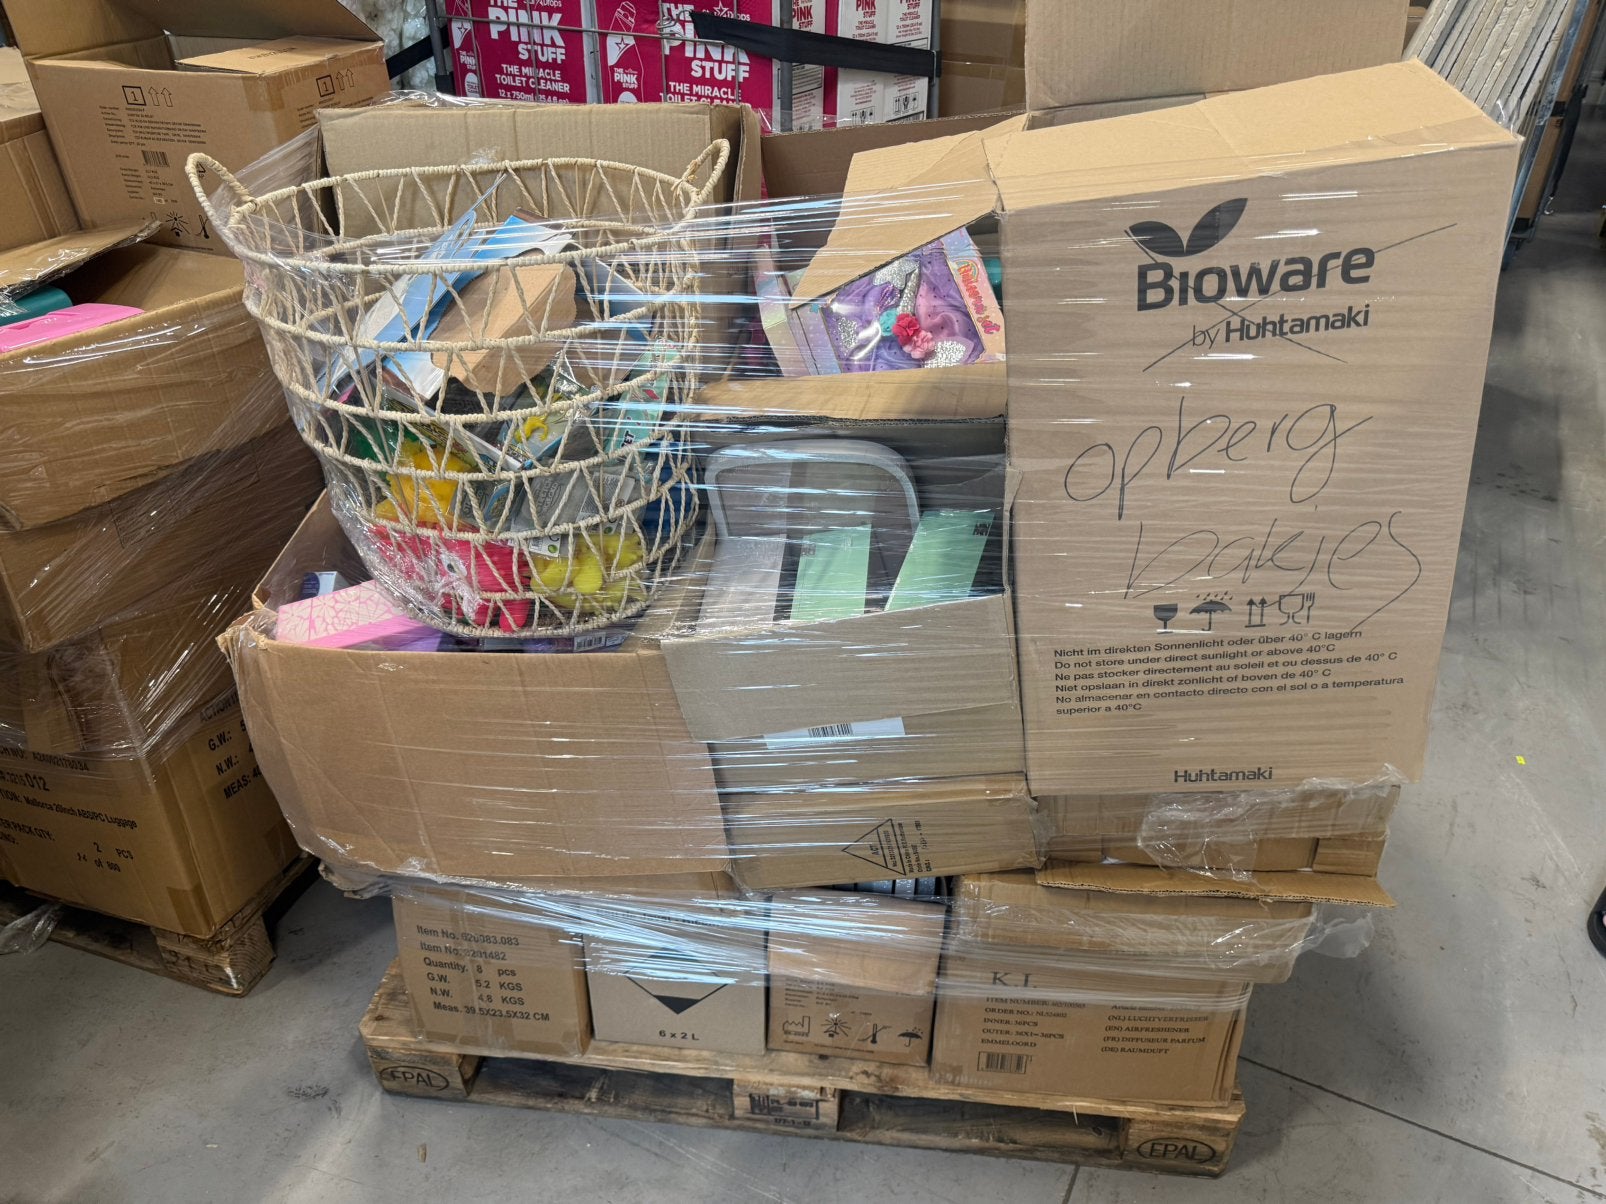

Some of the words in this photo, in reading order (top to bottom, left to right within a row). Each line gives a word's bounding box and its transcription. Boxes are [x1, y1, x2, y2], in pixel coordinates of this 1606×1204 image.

[662, 2, 695, 21] THE
[863, 11, 876, 19] STUFF
[488, 7, 565, 47] PINK
[799, 20, 813, 30] STUFF
[518, 44, 566, 64] STUFF
[501, 64, 520, 75] THE
[691, 60, 750, 82] STUFF
[495, 74, 527, 87] TOILET
[614, 73, 638, 84] PINK
[322, 82, 329, 92] 1
[669, 81, 690, 94] THE
[130, 91, 139, 102] 1
[1193, 324, 1219, 349] by
[1225, 304, 1370, 343] Huhtamaki
[1054, 648, 1084, 658] Nicht
[1087, 648, 1101, 656] im
[1104, 645, 1151, 655] direkten
[1154, 640, 1224, 652] Sonnenlicht
[1228, 637, 1255, 647] oder
[1258, 635, 1285, 645] über
[1288, 633, 1308, 643] 40°
[1311, 632, 1321, 641] C
[1324, 630, 1362, 641] lagern
[1054, 660, 1071, 670] Do
[1074, 660, 1092, 669] not
[1095, 658, 1125, 667] store
[1127, 656, 1162, 665] under
[1164, 653, 1198, 663] direct
[1201, 650, 1248, 661] sunlight
[1251, 650, 1264, 658] or
[1266, 647, 1303, 657] above
[1306, 643, 1336, 654] 40°C
[1055, 673, 1071, 682] Ne
[1073, 672, 1095, 683] pas
[1097, 669, 1140, 680] stocker
[1143, 664, 1213, 677] directement
[1215, 663, 1231, 672] au
[1233, 660, 1264, 670] soleil
[1267, 660, 1279, 668] et
[1282, 659, 1297, 667] ou
[1300, 656, 1343, 666] dessus
[1346, 655, 1362, 663] de
[1364, 652, 1385, 662] 40°
[1388, 651, 1398, 660] C
[1055, 684, 1078, 693] Niet
[1080, 682, 1125, 693] opslaan
[1128, 680, 1139, 689] in
[1142, 678, 1174, 688] direkt
[1177, 675, 1223, 686] zonlicht
[1226, 674, 1238, 682] of
[1241, 672, 1278, 682] boven
[1281, 671, 1297, 679] de
[1298, 669, 1319, 679] 40°
[1322, 668, 1332, 677] C
[1056, 695, 1072, 704] No
[1075, 693, 1132, 703] almacenar
[1136, 692, 1150, 700] en
[1153, 689, 1204, 699] contacto
[1207, 686, 1248, 696] directo
[1251, 685, 1273, 693] con
[1276, 683, 1287, 692] el
[1290, 682, 1307, 691] sol
[1311, 682, 1318, 690] o
[1332, 677, 1404, 689] temperatura
[1056, 704, 1101, 716] superior
[1104, 705, 1112, 713] a
[1114, 702, 1142, 712] 40°C
[208, 730, 232, 751] G.W.:
[216, 755, 240, 776] N.W.:
[1173, 766, 1273, 783] Huhtamaki
[223, 774, 251, 799] MEAS:
[105, 814, 138, 830] Luggage
[93, 842, 102, 853] 2
[416, 924, 439, 938] Item
[441, 930, 459, 941] No.
[420, 941, 443, 954] Item
[444, 946, 462, 957] No.
[476, 965, 483, 974] 8
[497, 968, 517, 978] pcs
[426, 972, 450, 984] G.W.
[475, 979, 491, 989] 5.2
[499, 981, 523, 992] KGS
[430, 986, 453, 998] N.W.
[478, 994, 493, 1004] 4.8
[501, 995, 525, 1006] KGS
[986, 996, 1008, 1004] ITEM
[433, 1000, 462, 1013] Meas.
[533, 1011, 550, 1022] CM
[985, 1007, 1014, 1015] ORDER
[1108, 1015, 1127, 1023] (NL)
[659, 1029, 666, 1038] 6
[681, 1032, 688, 1040] 2
[692, 1033, 700, 1041] L
[1124, 1025, 1190, 1033] AIRFRESHENER
[980, 1038, 1037, 1048] EMMELOORD
[1121, 1036, 1169, 1044] DIFFUSEUR
[1169, 1036, 1206, 1044] PARFUM
[1149, 1142, 1201, 1162] EPAL
